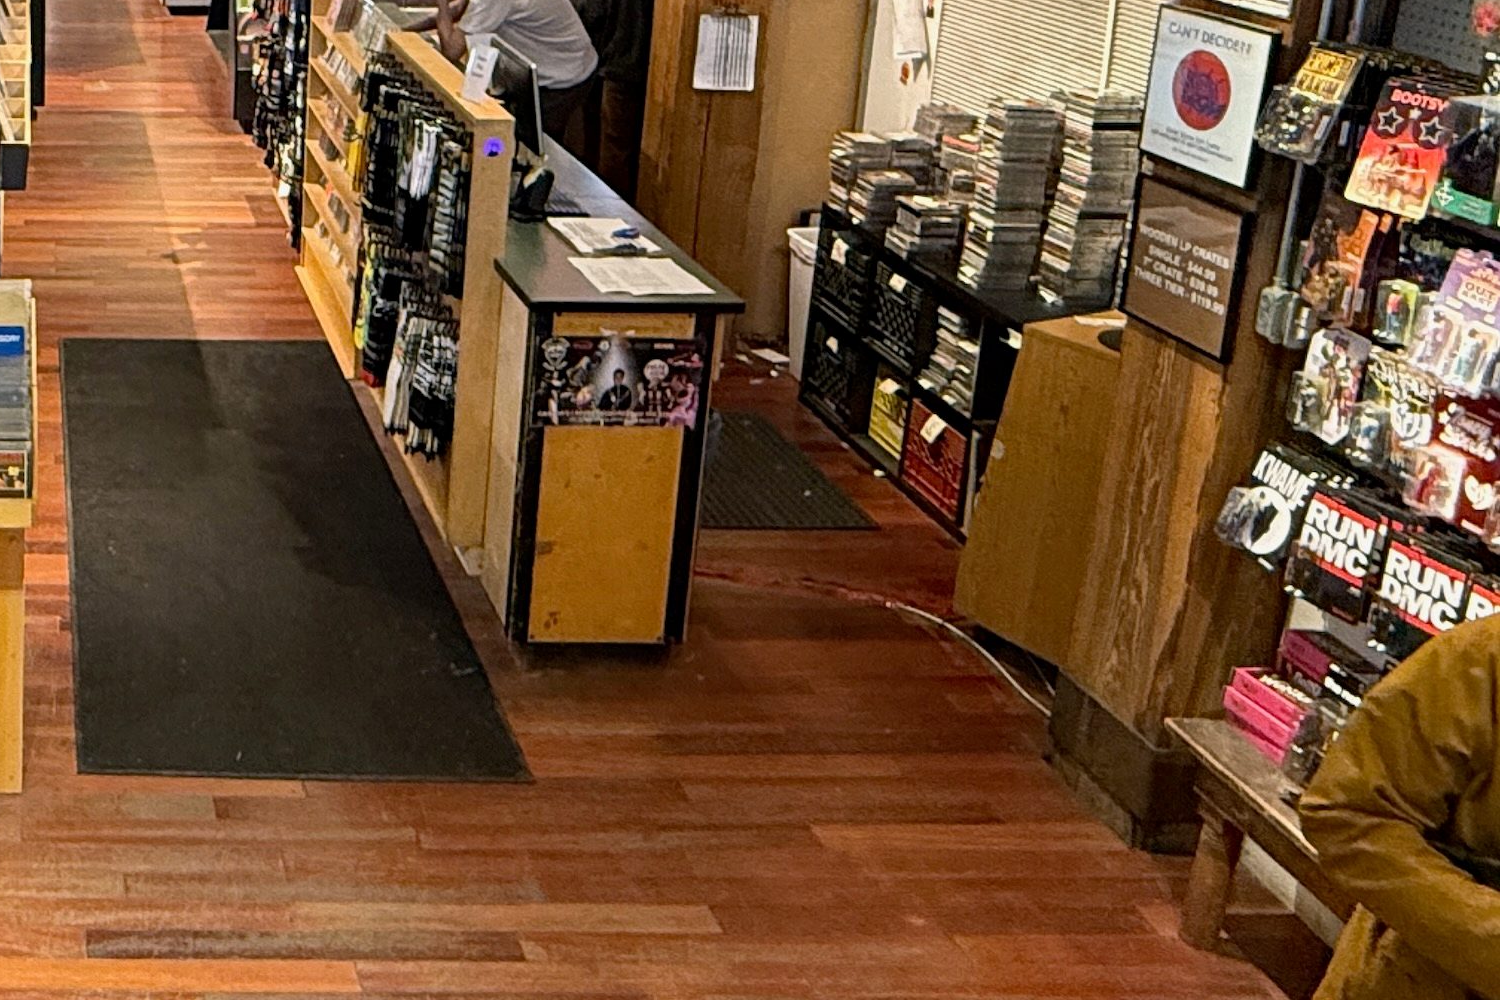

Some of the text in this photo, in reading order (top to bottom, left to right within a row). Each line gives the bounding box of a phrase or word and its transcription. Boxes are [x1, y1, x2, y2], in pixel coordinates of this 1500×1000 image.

[1391, 88, 1449, 112] BOOTSY
[1179, 239, 1192, 252] LP
[1192, 245, 1230, 269] CRATES
[1465, 281, 1497, 301] OUT
[1252, 451, 1316, 511] KWAME
[1300, 524, 1370, 578] DMC
[1304, 499, 1375, 554] RUN
[1381, 575, 1458, 631] DMC
[1385, 547, 1465, 608] RUN
